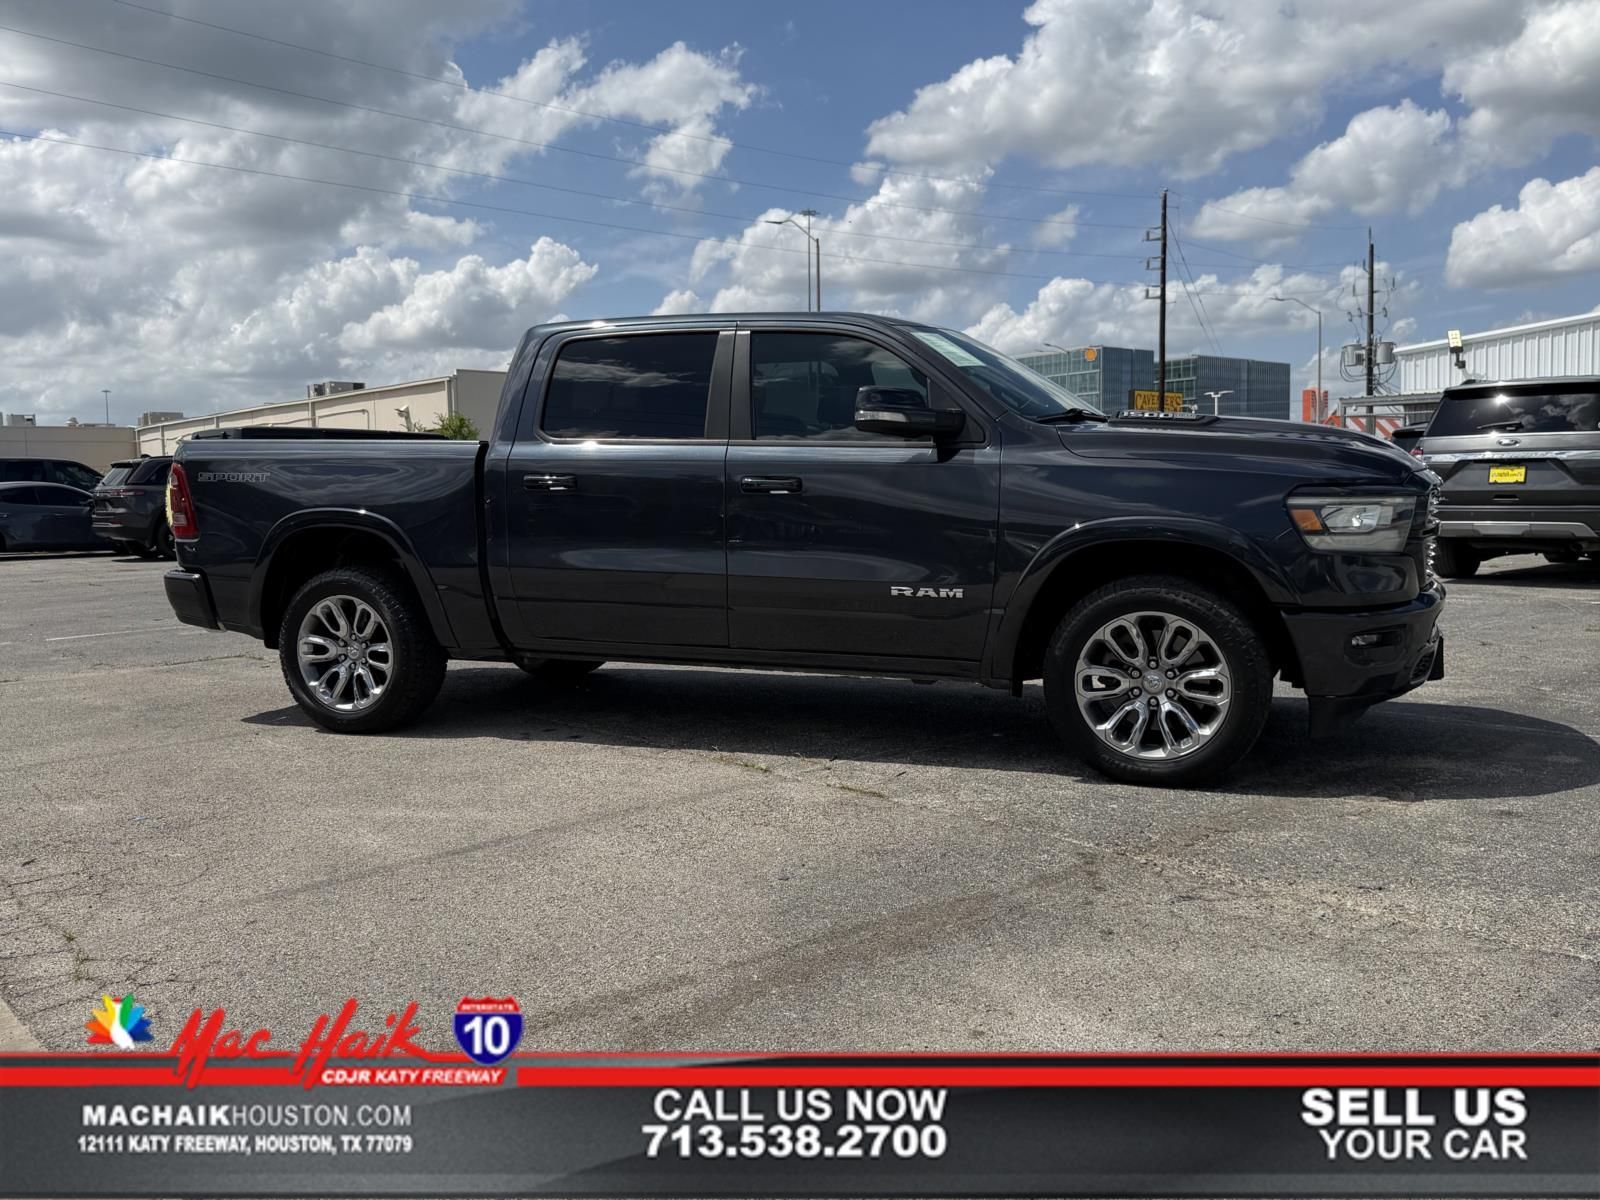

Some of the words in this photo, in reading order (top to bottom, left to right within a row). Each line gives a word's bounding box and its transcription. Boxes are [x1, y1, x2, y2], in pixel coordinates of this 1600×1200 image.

[1136, 392, 1182, 409] CAVEER'S
[198, 472, 270, 483] SPORT
[891, 586, 963, 598] RAM
